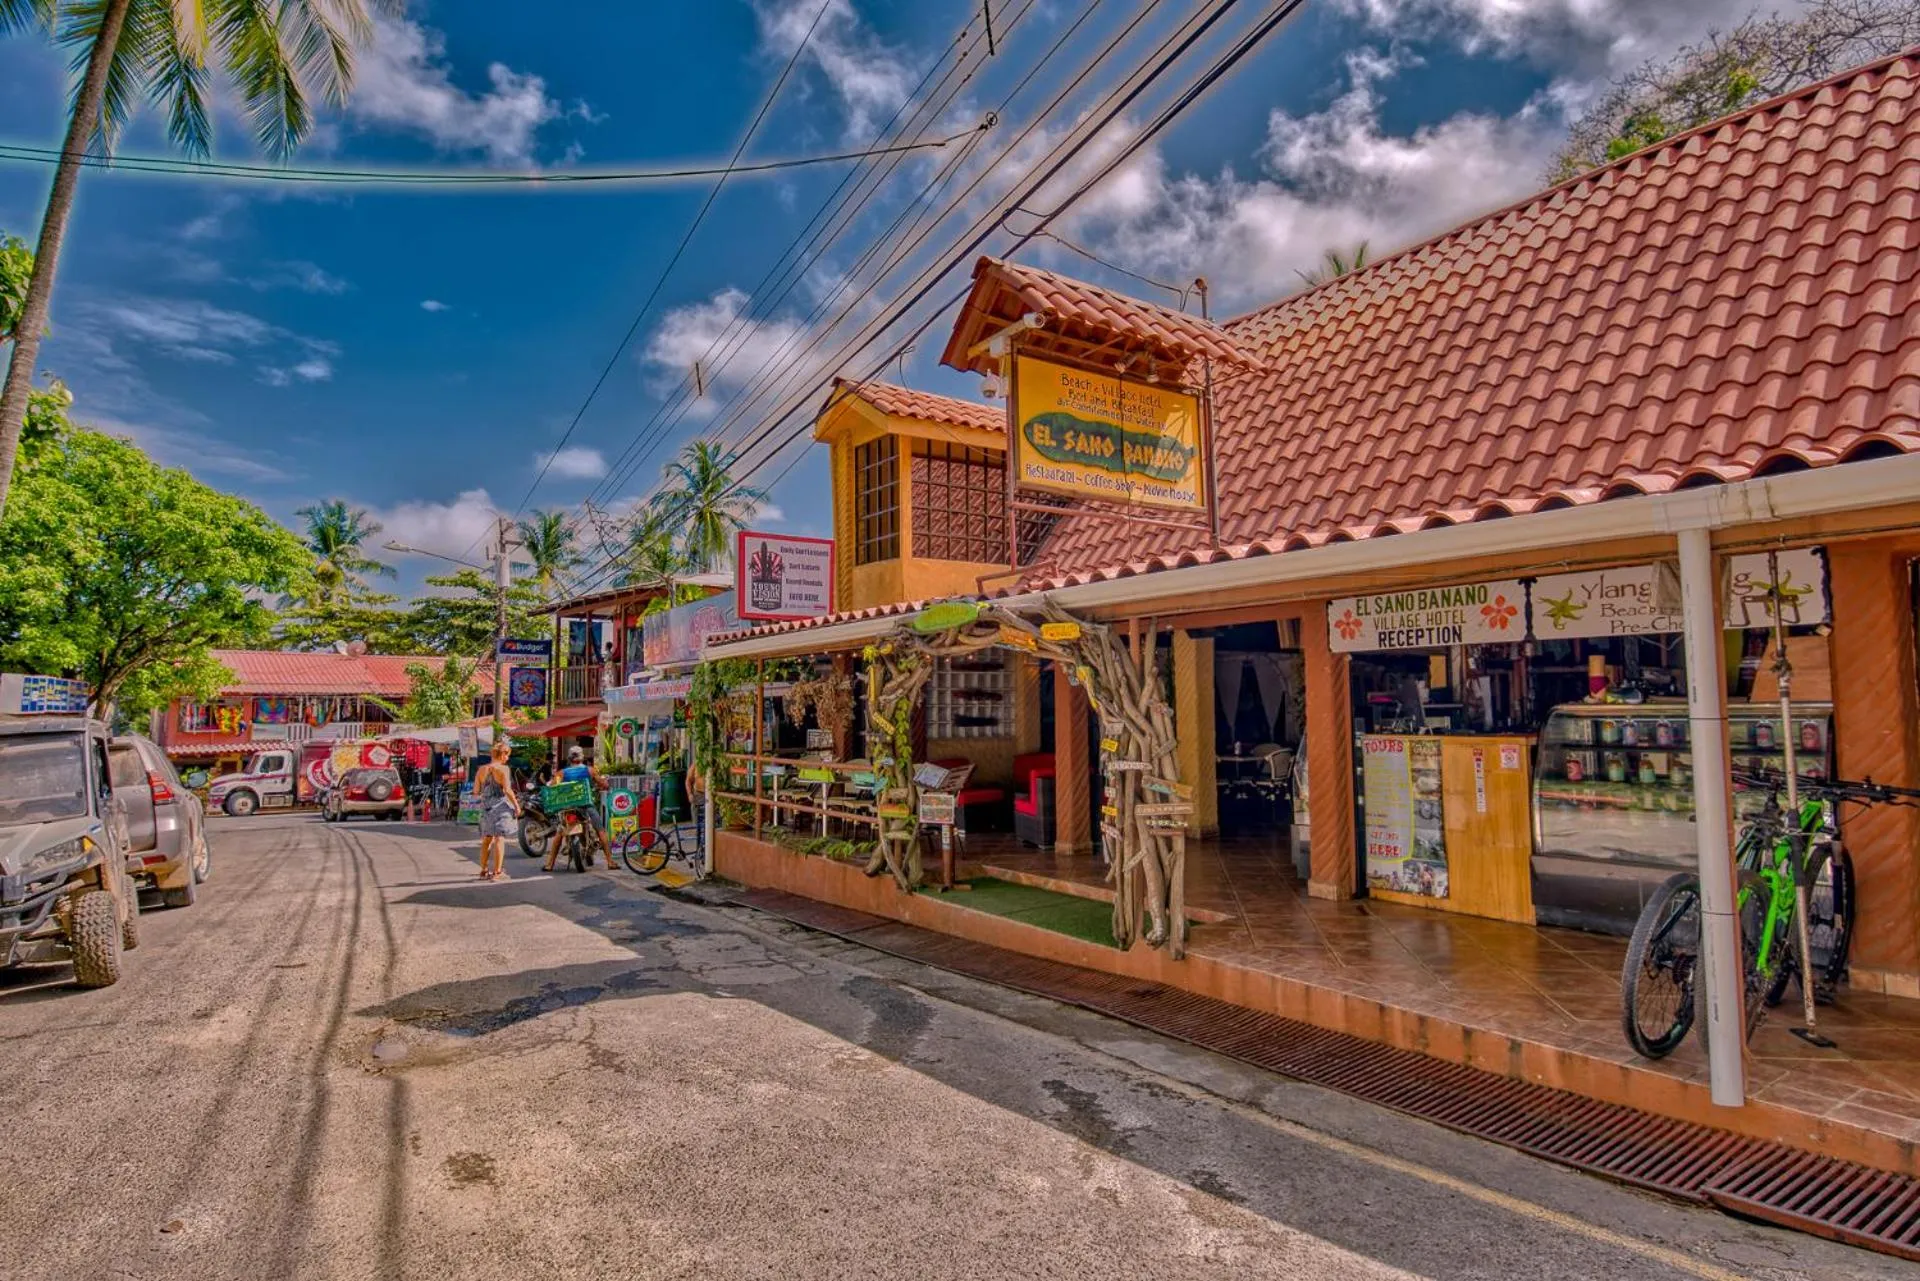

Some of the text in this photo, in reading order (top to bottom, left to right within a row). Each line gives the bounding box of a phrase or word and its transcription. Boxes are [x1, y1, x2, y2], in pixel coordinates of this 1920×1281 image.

[1032, 422, 1185, 472] EL SANO BANANO
[1026, 463, 1075, 484] Restaurant
[1355, 584, 1489, 617] EL SANO BANANO
[1372, 609, 1467, 631] VILLAGE HOTEL
[516, 642, 544, 653] Budget
[1378, 624, 1463, 649] RECEPTION
[1363, 739, 1405, 753] TOURS
